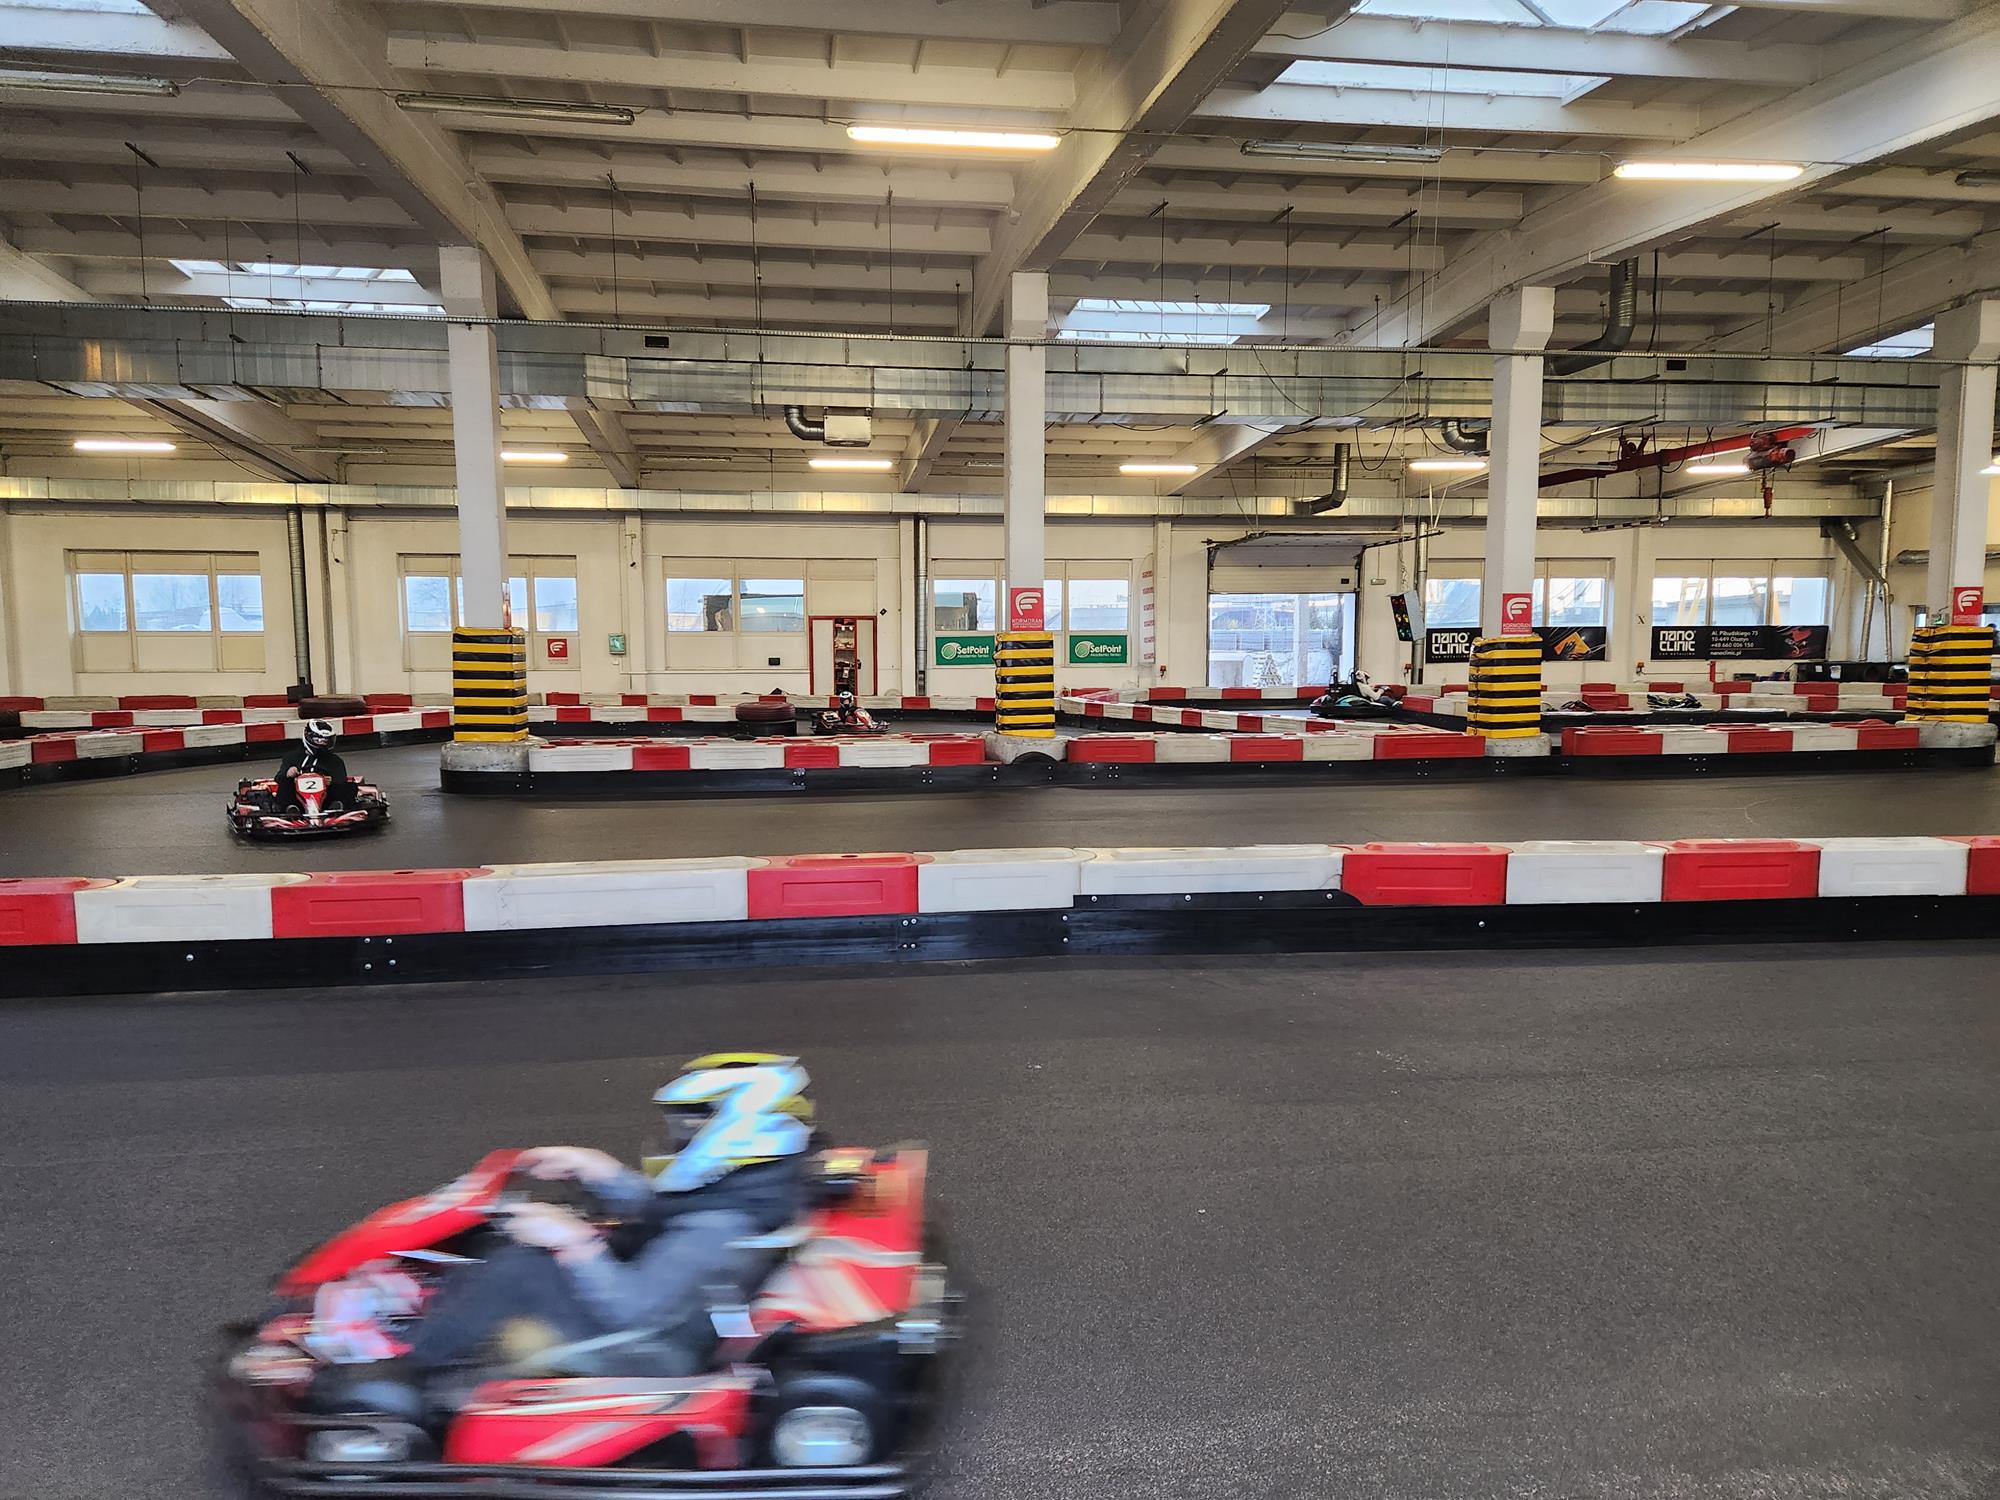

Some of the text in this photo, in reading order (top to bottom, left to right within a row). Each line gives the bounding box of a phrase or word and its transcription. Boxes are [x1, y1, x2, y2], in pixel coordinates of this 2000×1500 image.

[957, 645, 989, 654] SetPoint
[1090, 644, 1121, 653] SetPoint
[306, 781, 317, 790] 2
